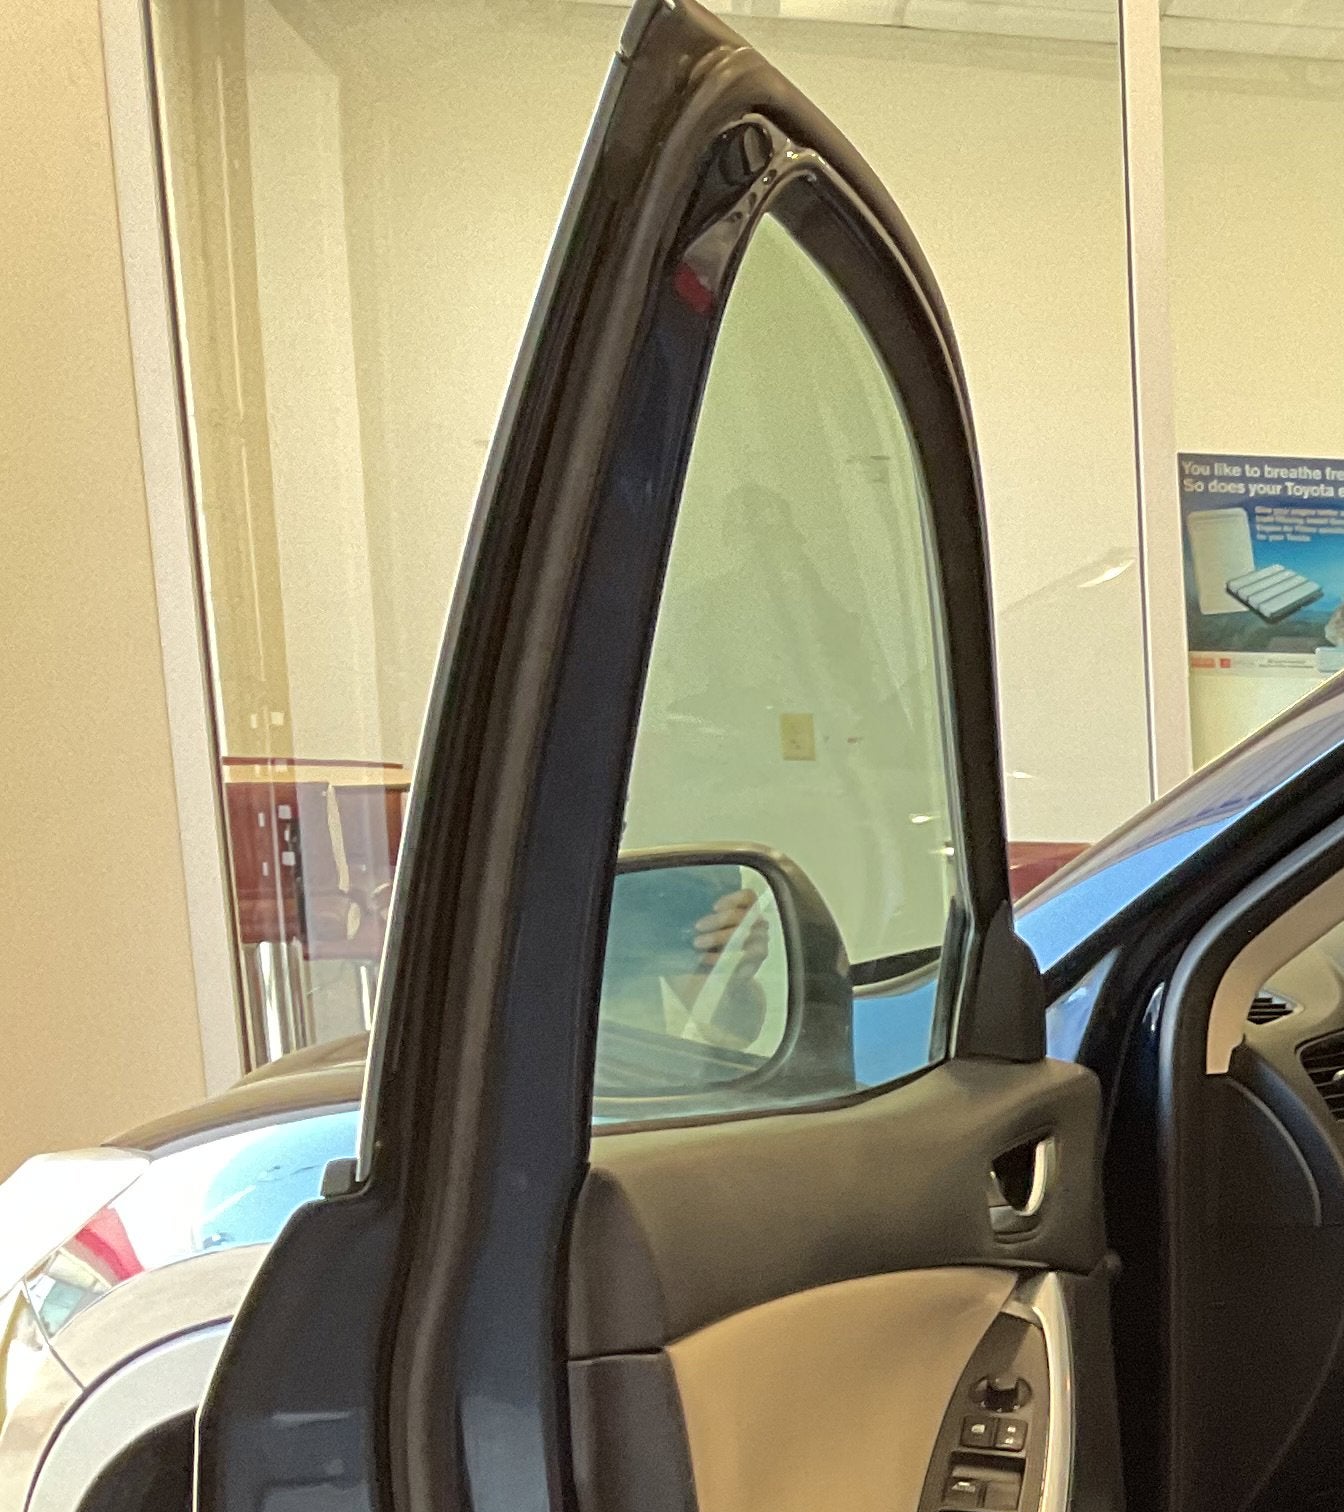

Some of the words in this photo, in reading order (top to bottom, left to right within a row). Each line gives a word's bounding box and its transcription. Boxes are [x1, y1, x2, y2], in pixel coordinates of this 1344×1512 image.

[1182, 460, 1210, 475] You
[1214, 462, 1241, 476] like
[1244, 463, 1261, 477] to
[1263, 464, 1322, 480] breathe
[1183, 478, 1205, 492] So
[1208, 479, 1246, 494] does
[1248, 482, 1282, 497] your
[1284, 481, 1335, 499] Toyota
